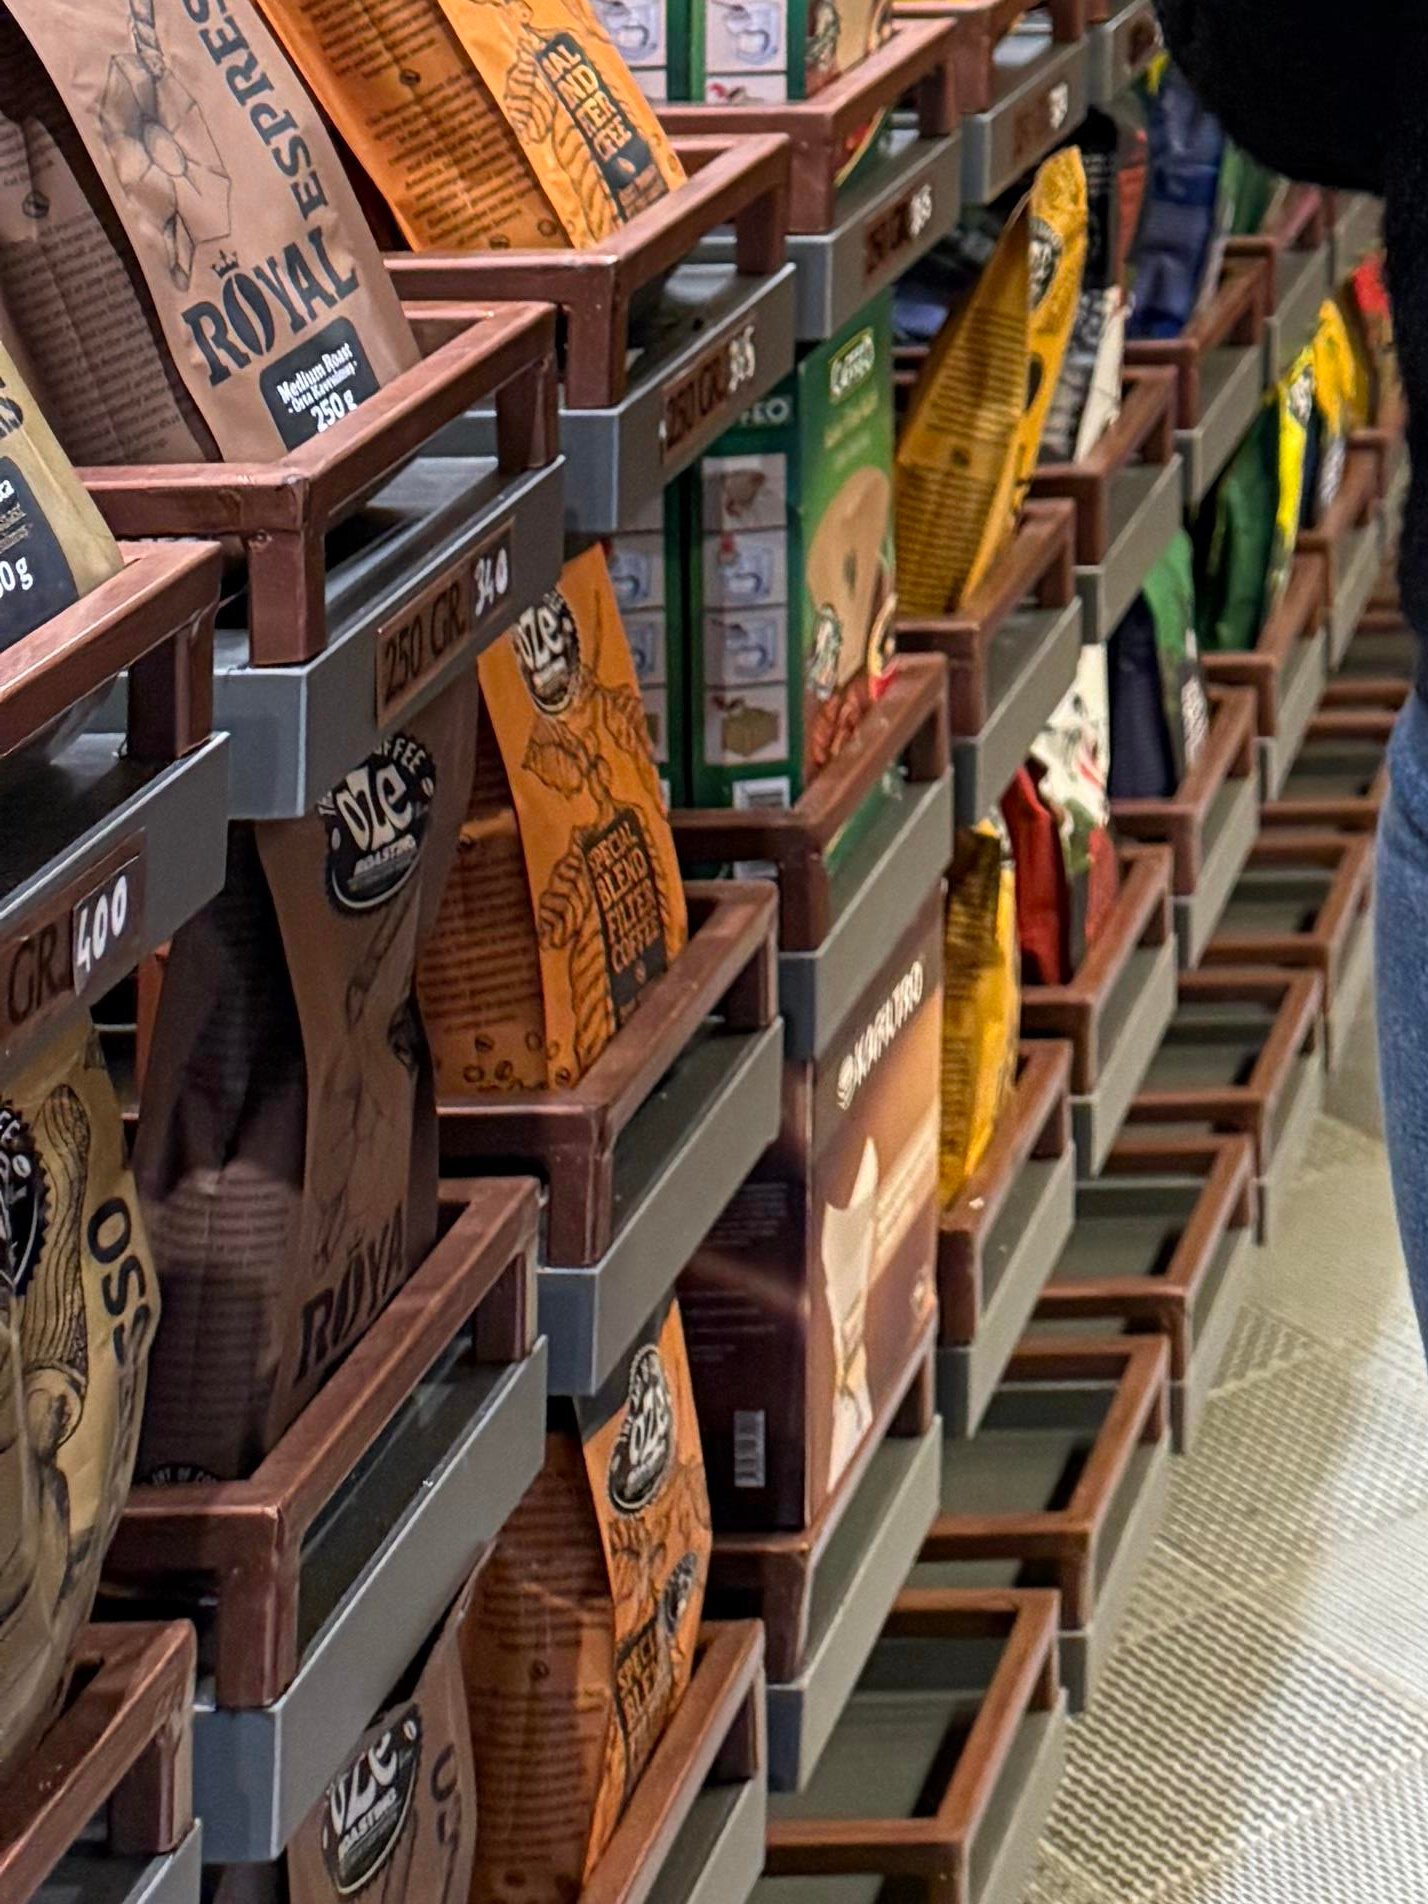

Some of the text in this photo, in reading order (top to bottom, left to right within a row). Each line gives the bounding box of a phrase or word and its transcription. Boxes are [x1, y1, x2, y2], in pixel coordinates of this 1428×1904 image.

[181, 226, 361, 388] ROYAL
[310, 391, 345, 433] 250
[385, 615, 423, 706] 250
[474, 547, 508, 617] 340
[596, 847, 649, 912] BLEND
[606, 877, 658, 944] FILTER
[76, 874, 128, 973] 400
